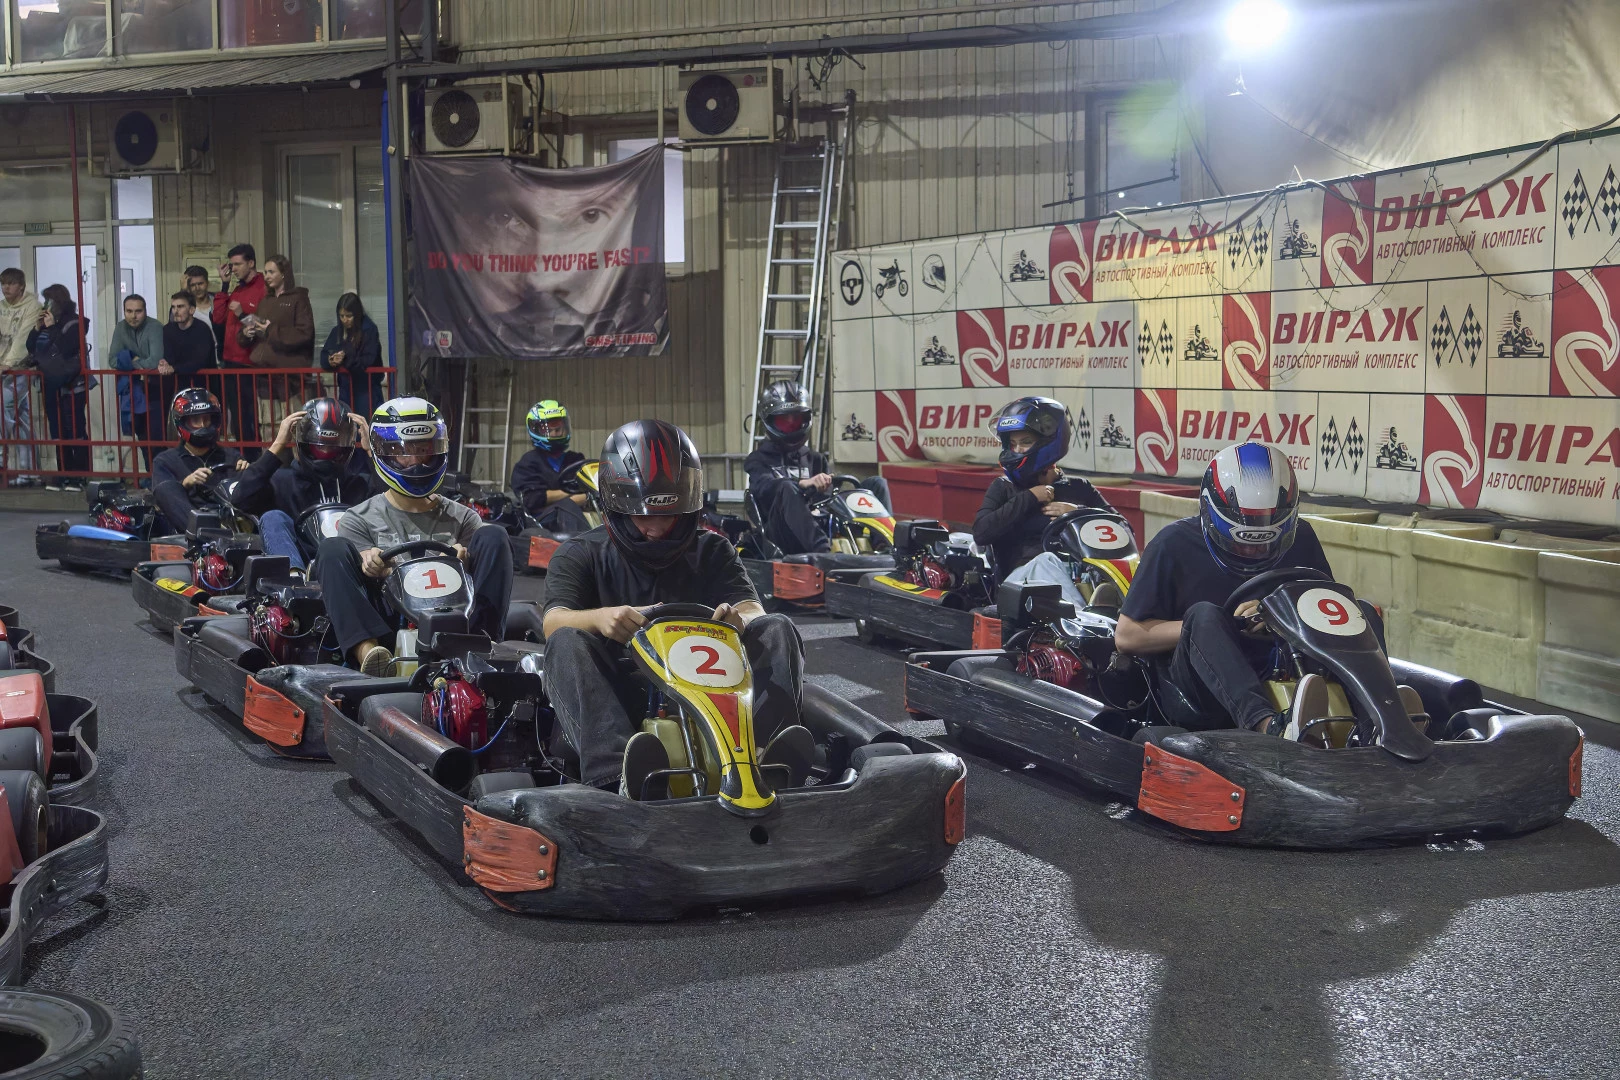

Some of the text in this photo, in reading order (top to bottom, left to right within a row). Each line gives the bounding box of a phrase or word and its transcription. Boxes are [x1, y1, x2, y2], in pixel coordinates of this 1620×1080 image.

[1376, 173, 1553, 233] ВИРАЖ
[1095, 221, 1223, 262] ВИРАЖ
[1376, 226, 1546, 259] АВТОСПОРТИВНЫЙ КОМПЛЕКС
[428, 251, 447, 269] DO
[451, 251, 484, 272] YOU
[488, 254, 539, 273] THINK
[542, 252, 599, 272] YOU'RE
[1095, 261, 1217, 283] АВТОСПОРТИВНЫЙ КОМПЛЕКС
[1008, 320, 1132, 350] ВИРАЖ
[1272, 306, 1424, 344] ВИРАЖ
[1010, 355, 1129, 369] АВТОСПОРТИВНЫЙ КОМПЛЕКС
[1272, 351, 1419, 369] АВТОСПОРТИВНЫЙ КОМПЛЕКС
[919, 405, 993, 429] ВИР
[1180, 410, 1316, 446] ВИРАЖ
[404, 426, 431, 434] HJC
[922, 436, 1002, 448] АВТОСПОРТИВНЫ
[1487, 422, 1620, 468] ВИРА
[1486, 472, 1605, 499] АВТОСПОРТИВНЫЙ
[647, 495, 677, 504] HJC
[858, 497, 873, 508] 4
[1094, 525, 1118, 543] 3
[1240, 531, 1274, 540] HJC
[422, 569, 446, 590] 1
[1317, 598, 1350, 626] 9
[690, 645, 727, 677] 2
